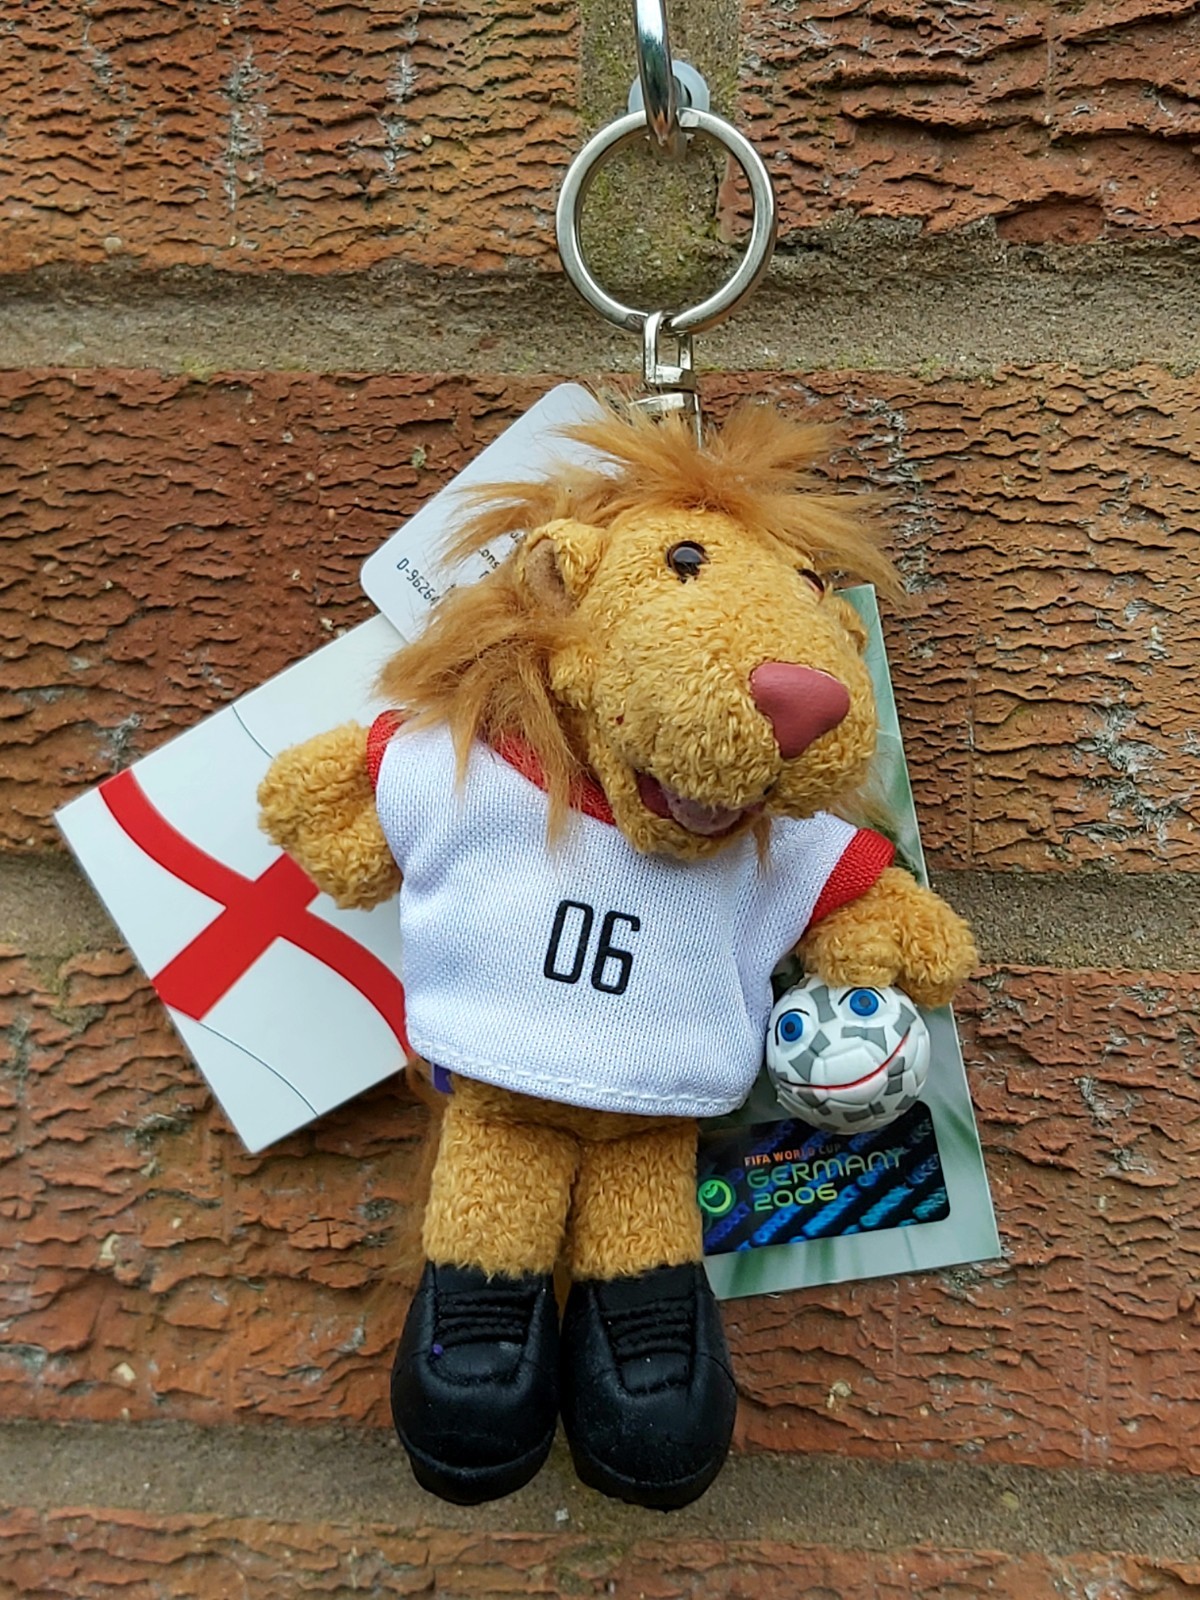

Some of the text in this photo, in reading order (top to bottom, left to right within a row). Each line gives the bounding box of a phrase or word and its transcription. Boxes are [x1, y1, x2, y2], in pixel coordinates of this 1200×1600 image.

[544, 900, 641, 996] 06
[744, 1145, 841, 1167] FIFA WORLD CUP
[747, 1149, 904, 1188] GERMANY
[754, 1182, 838, 1212] 2006
